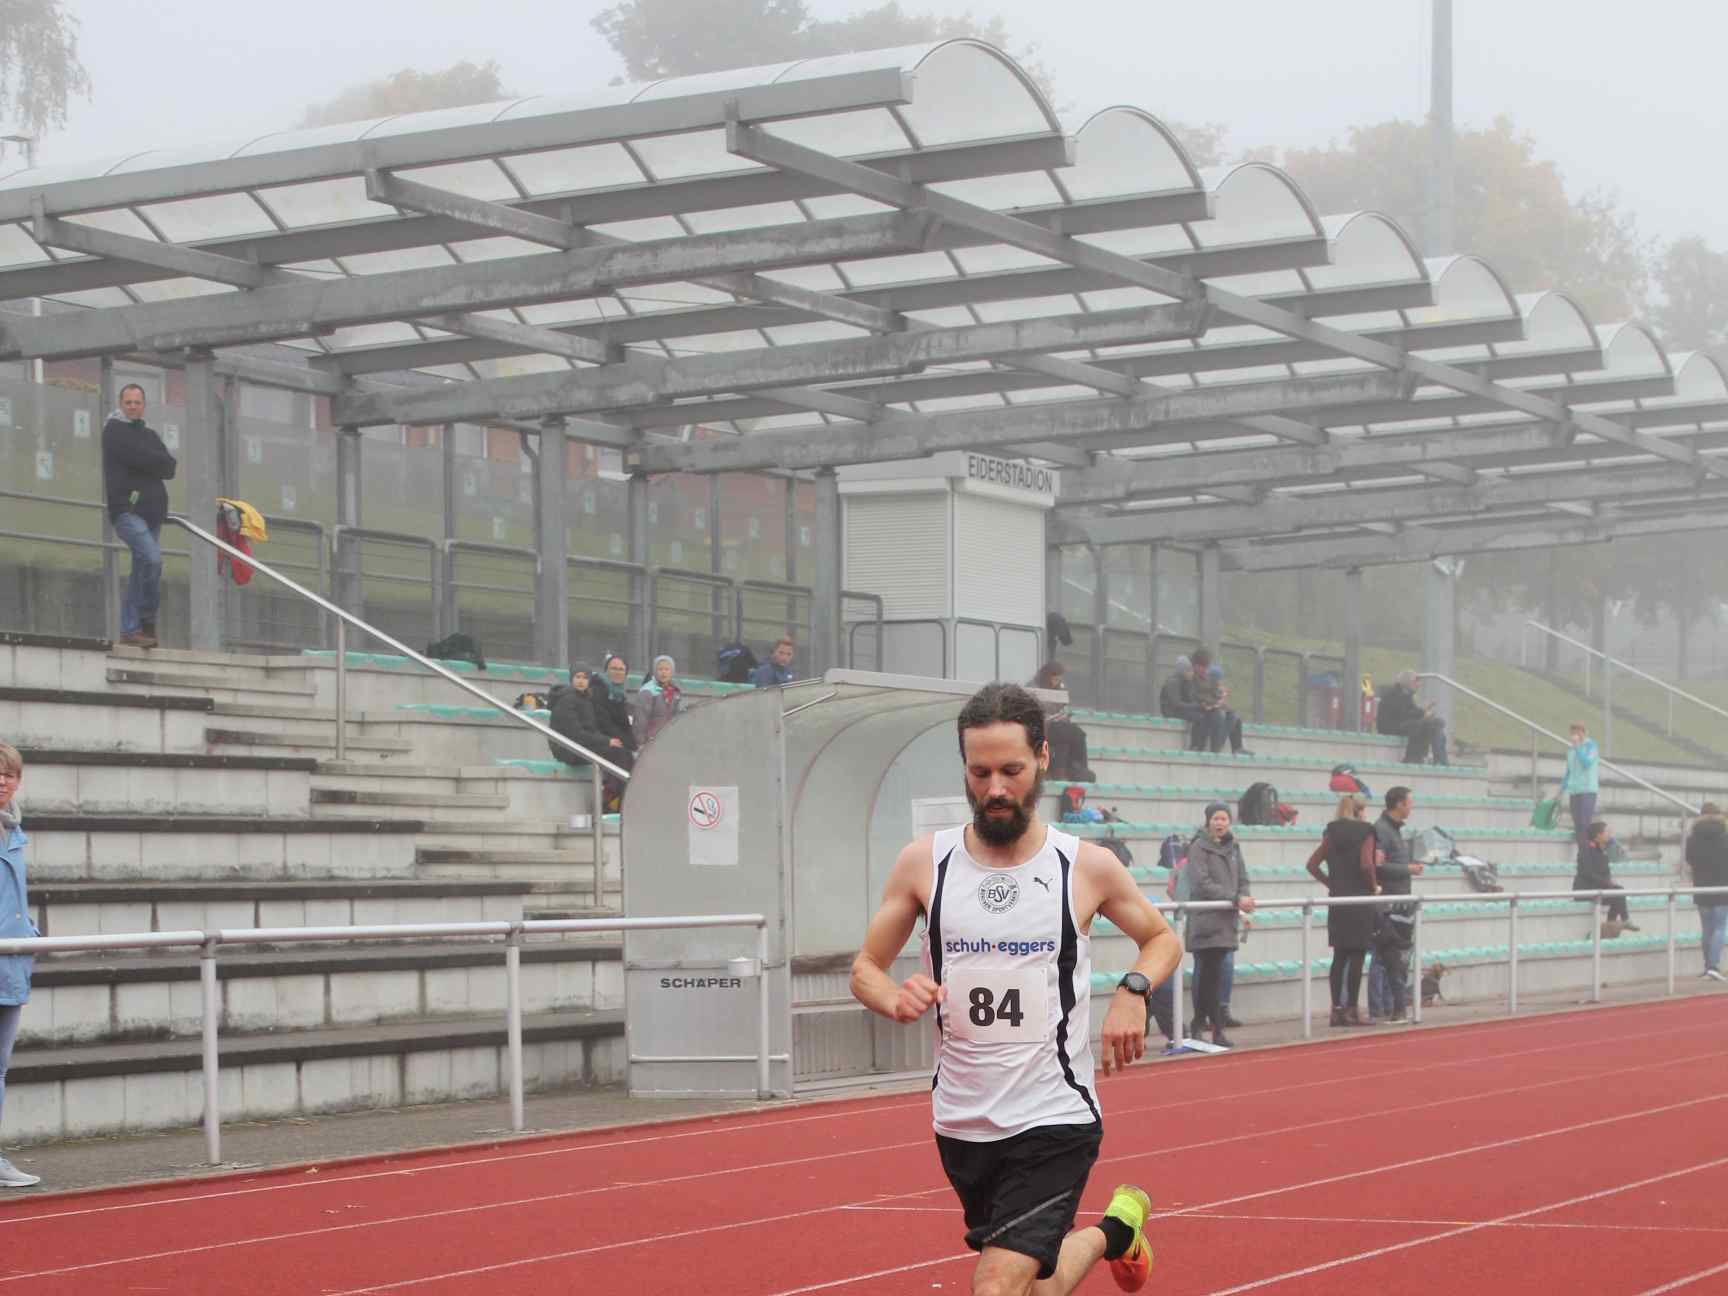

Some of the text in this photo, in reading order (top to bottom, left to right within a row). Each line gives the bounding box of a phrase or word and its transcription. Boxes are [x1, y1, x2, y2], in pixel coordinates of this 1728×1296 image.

[968, 455, 1052, 492] EIDERSTADION
[988, 885, 1010, 903] BSV
[969, 987, 1024, 1027] 84
